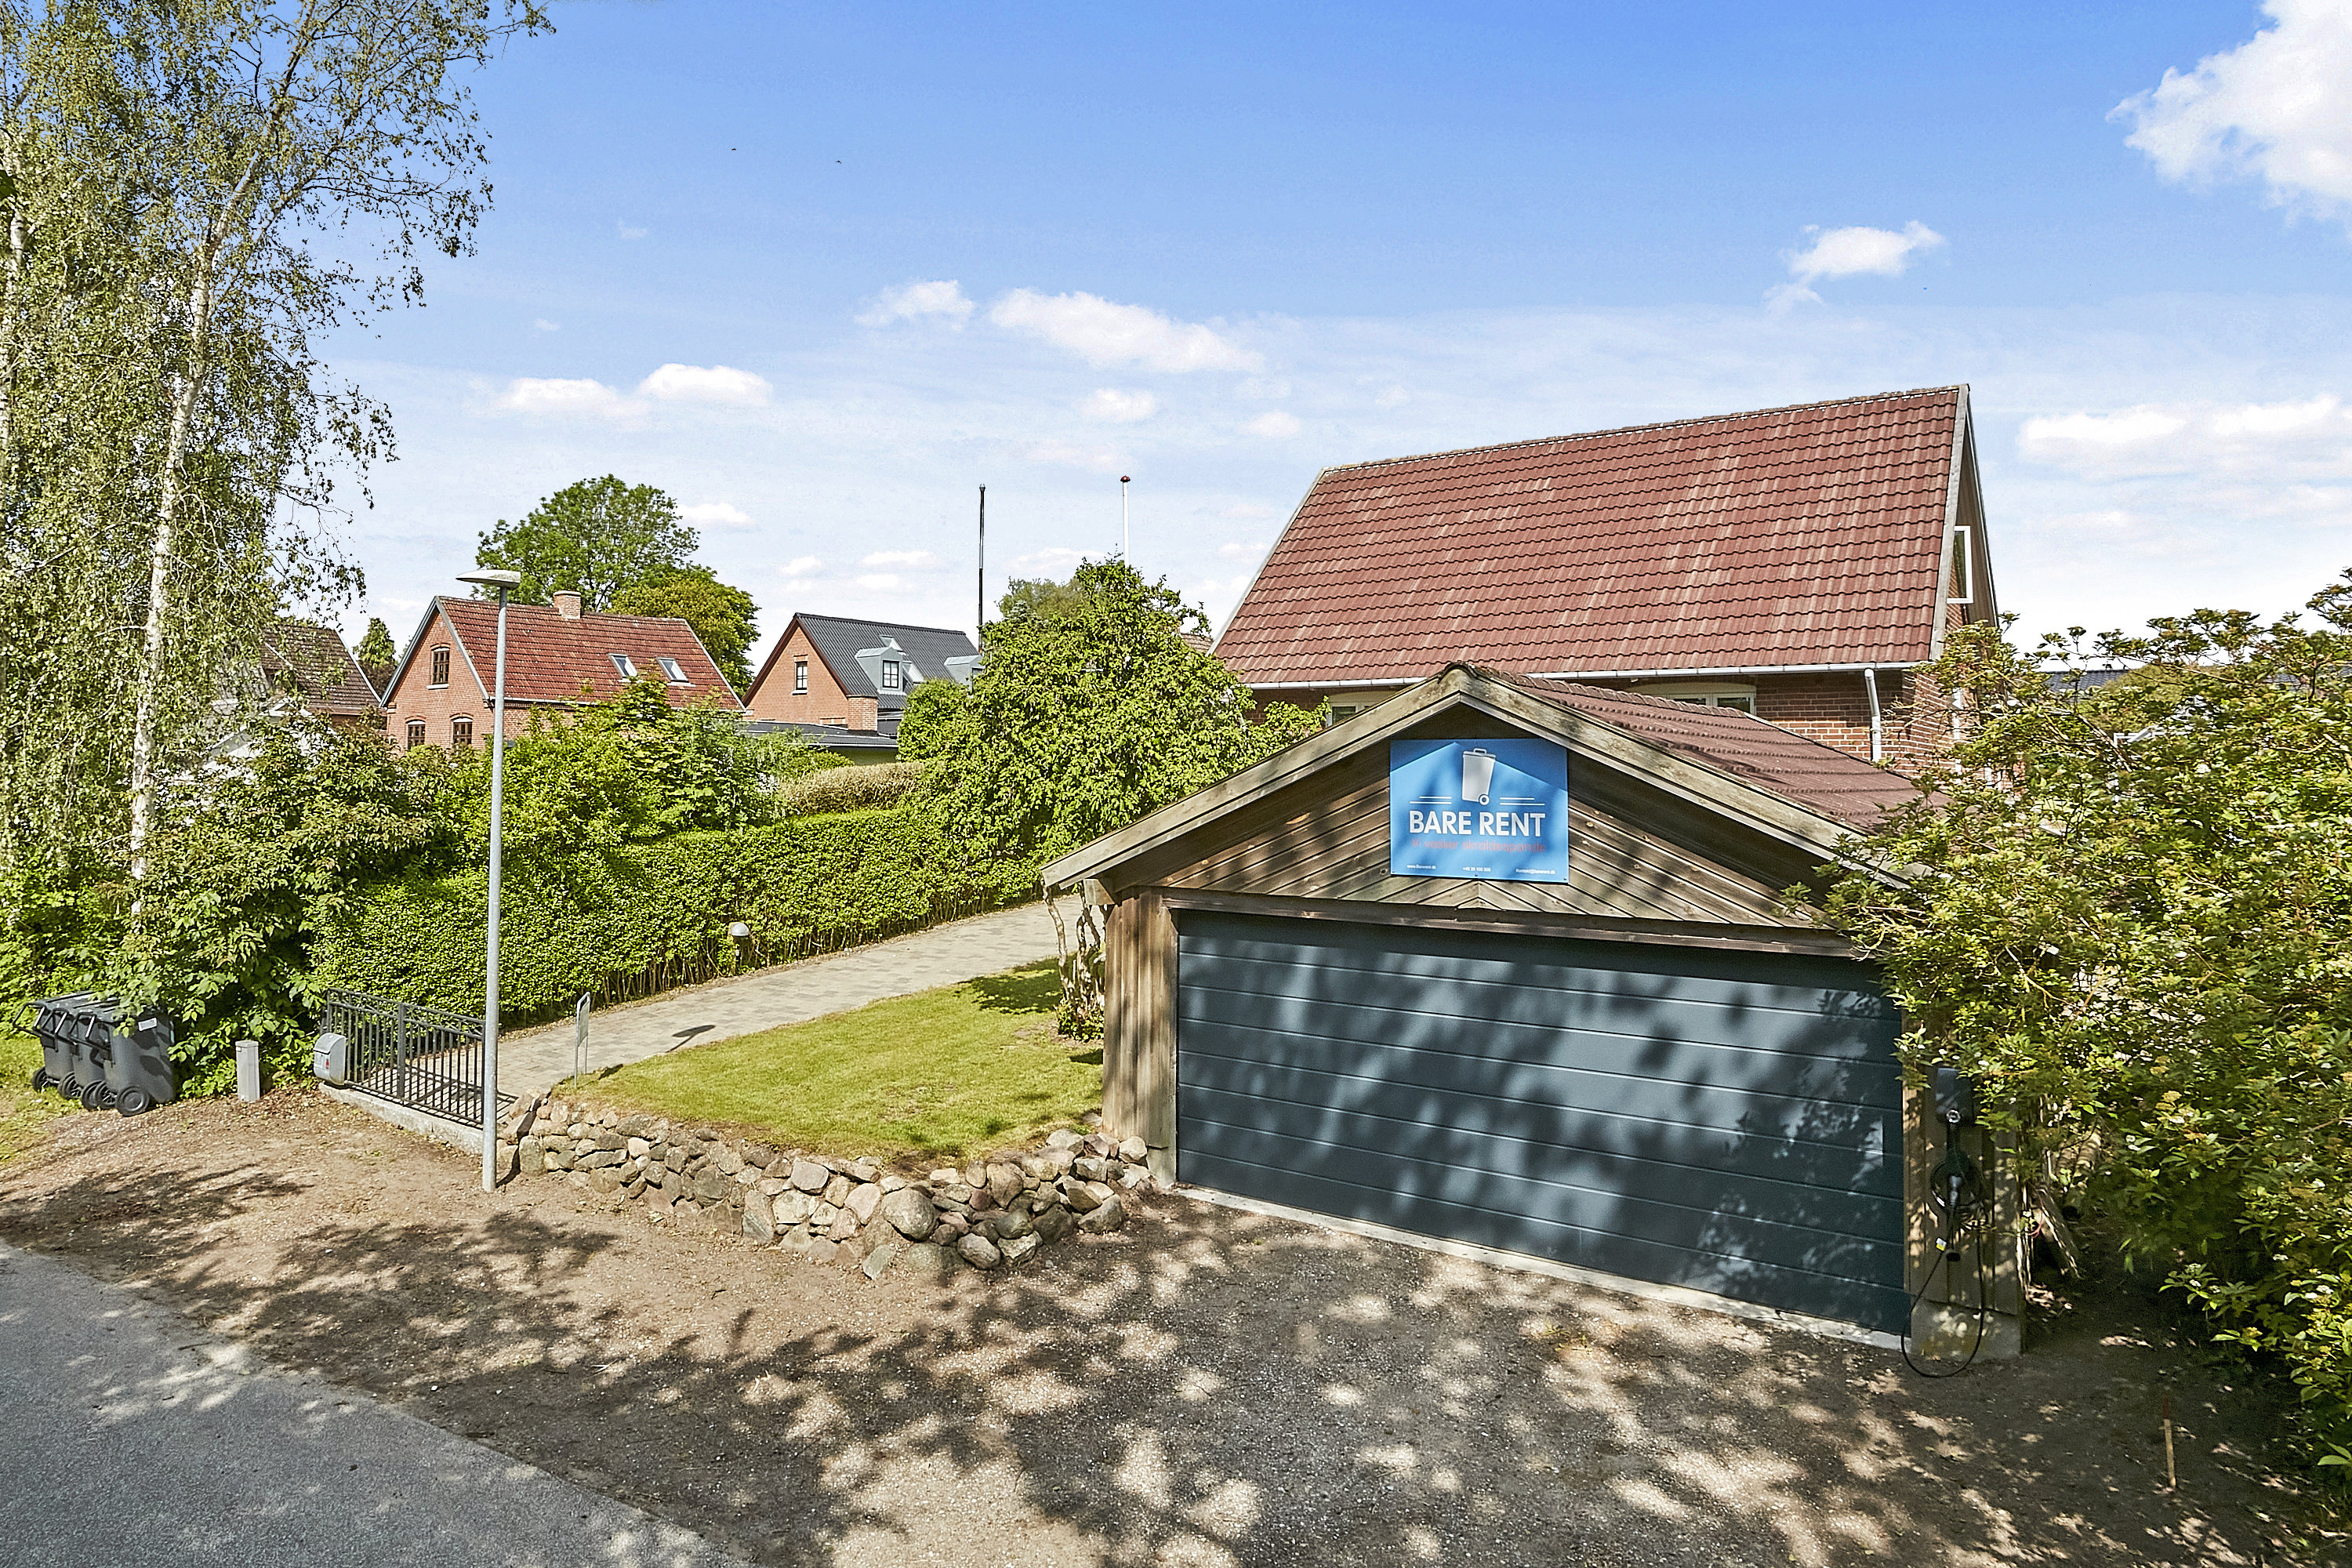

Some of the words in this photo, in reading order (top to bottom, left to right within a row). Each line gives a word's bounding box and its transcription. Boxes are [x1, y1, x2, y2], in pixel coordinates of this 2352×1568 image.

[1410, 810, 1472, 835] BARE
[1479, 811, 1545, 837] RENT
[1410, 838, 1421, 848] Vi
[1424, 838, 1458, 850] vasker
[1461, 839, 1545, 853] skraldespande
